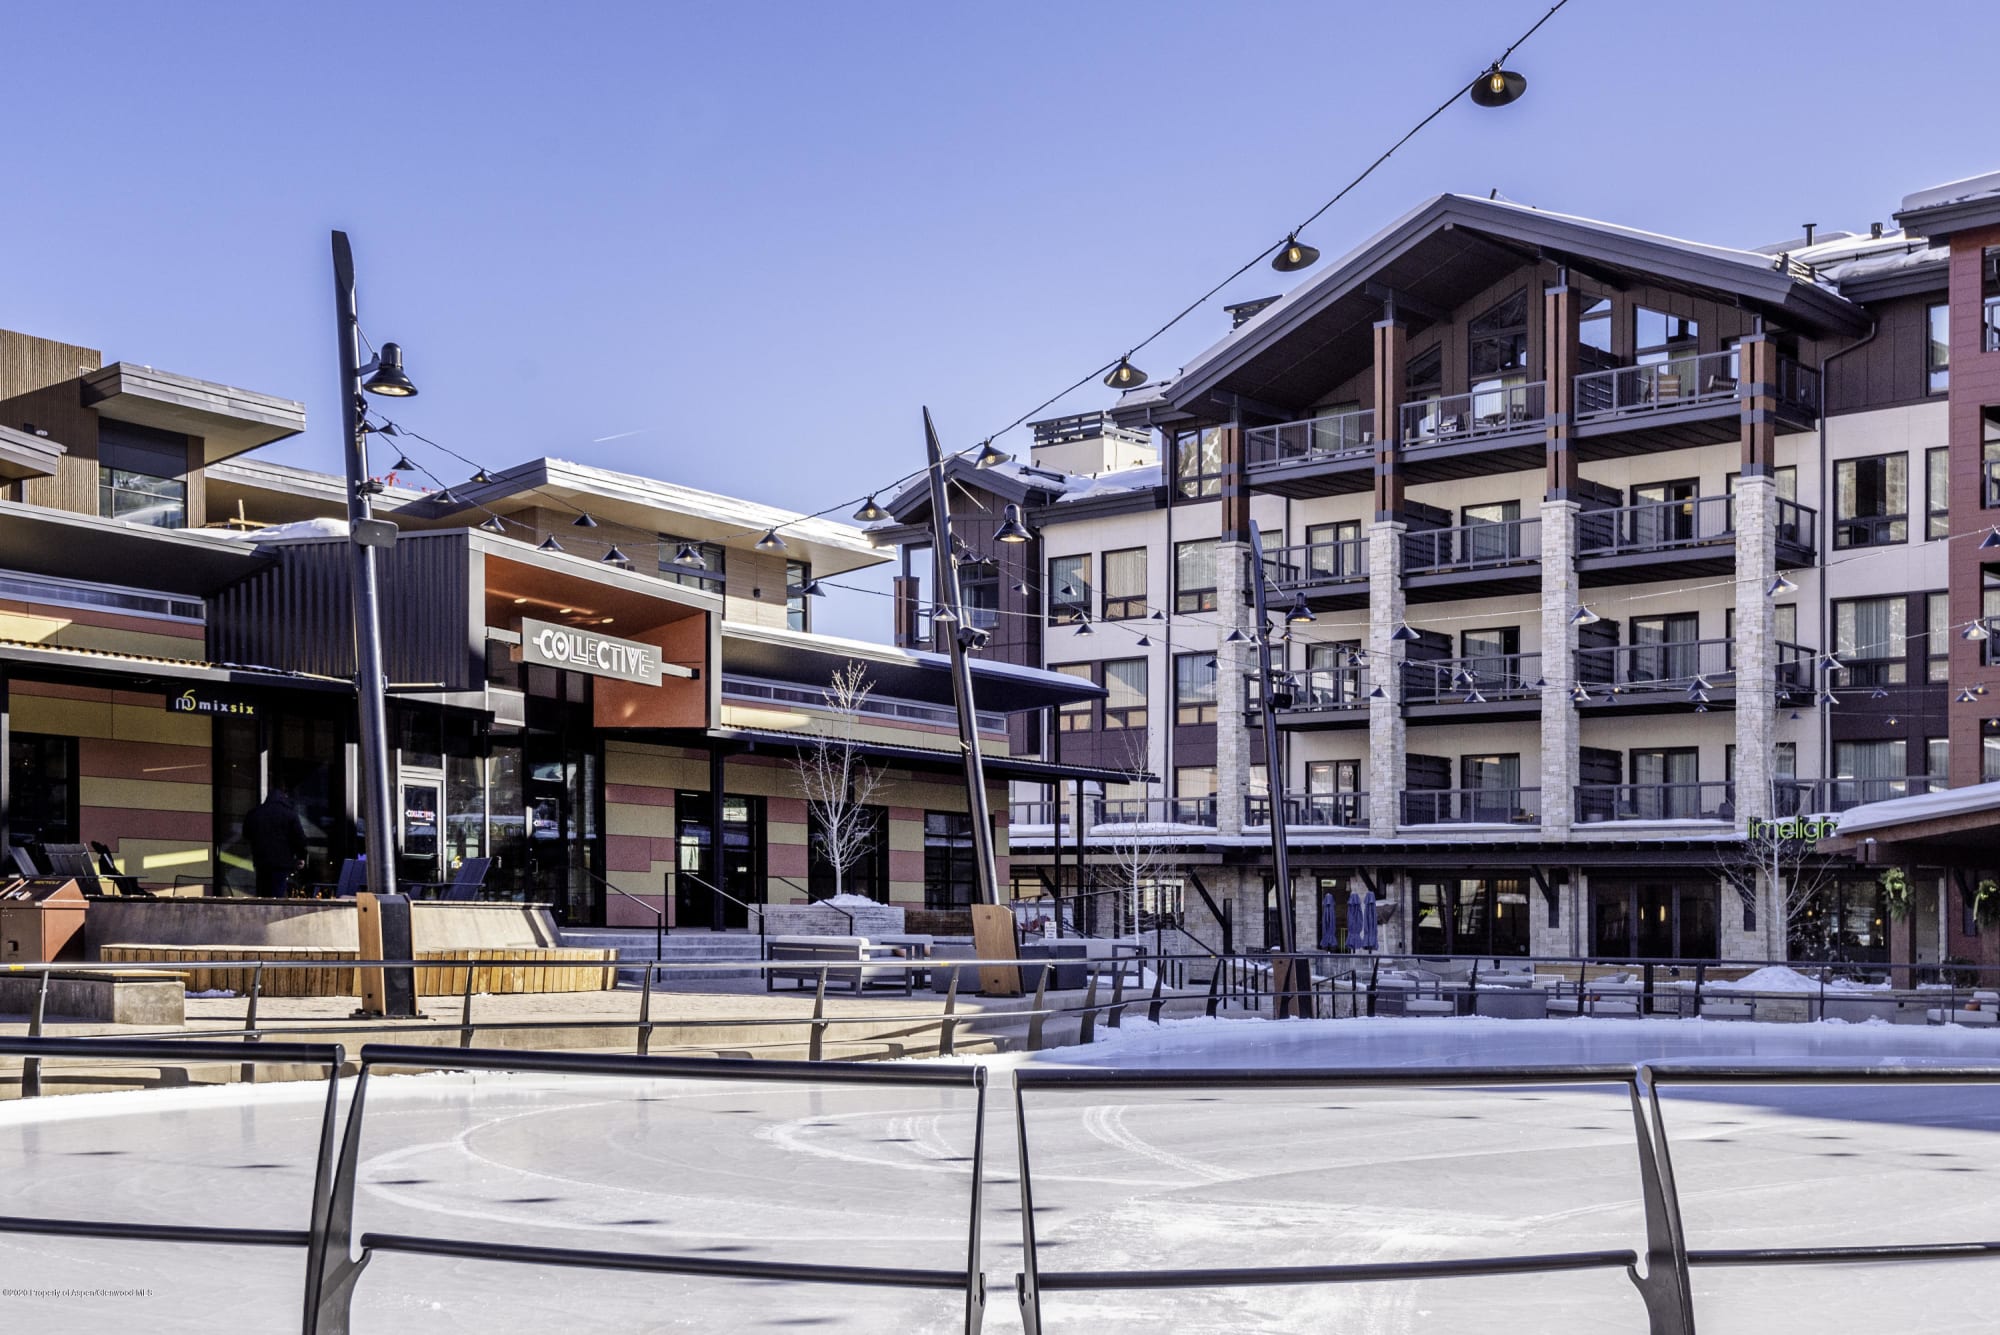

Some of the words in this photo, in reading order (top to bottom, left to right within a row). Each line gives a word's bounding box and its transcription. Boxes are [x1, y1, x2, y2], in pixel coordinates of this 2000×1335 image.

[532, 629, 655, 678] COLLECTIVE
[199, 700, 254, 715] mixsix
[1747, 816, 1838, 843] limeligh
